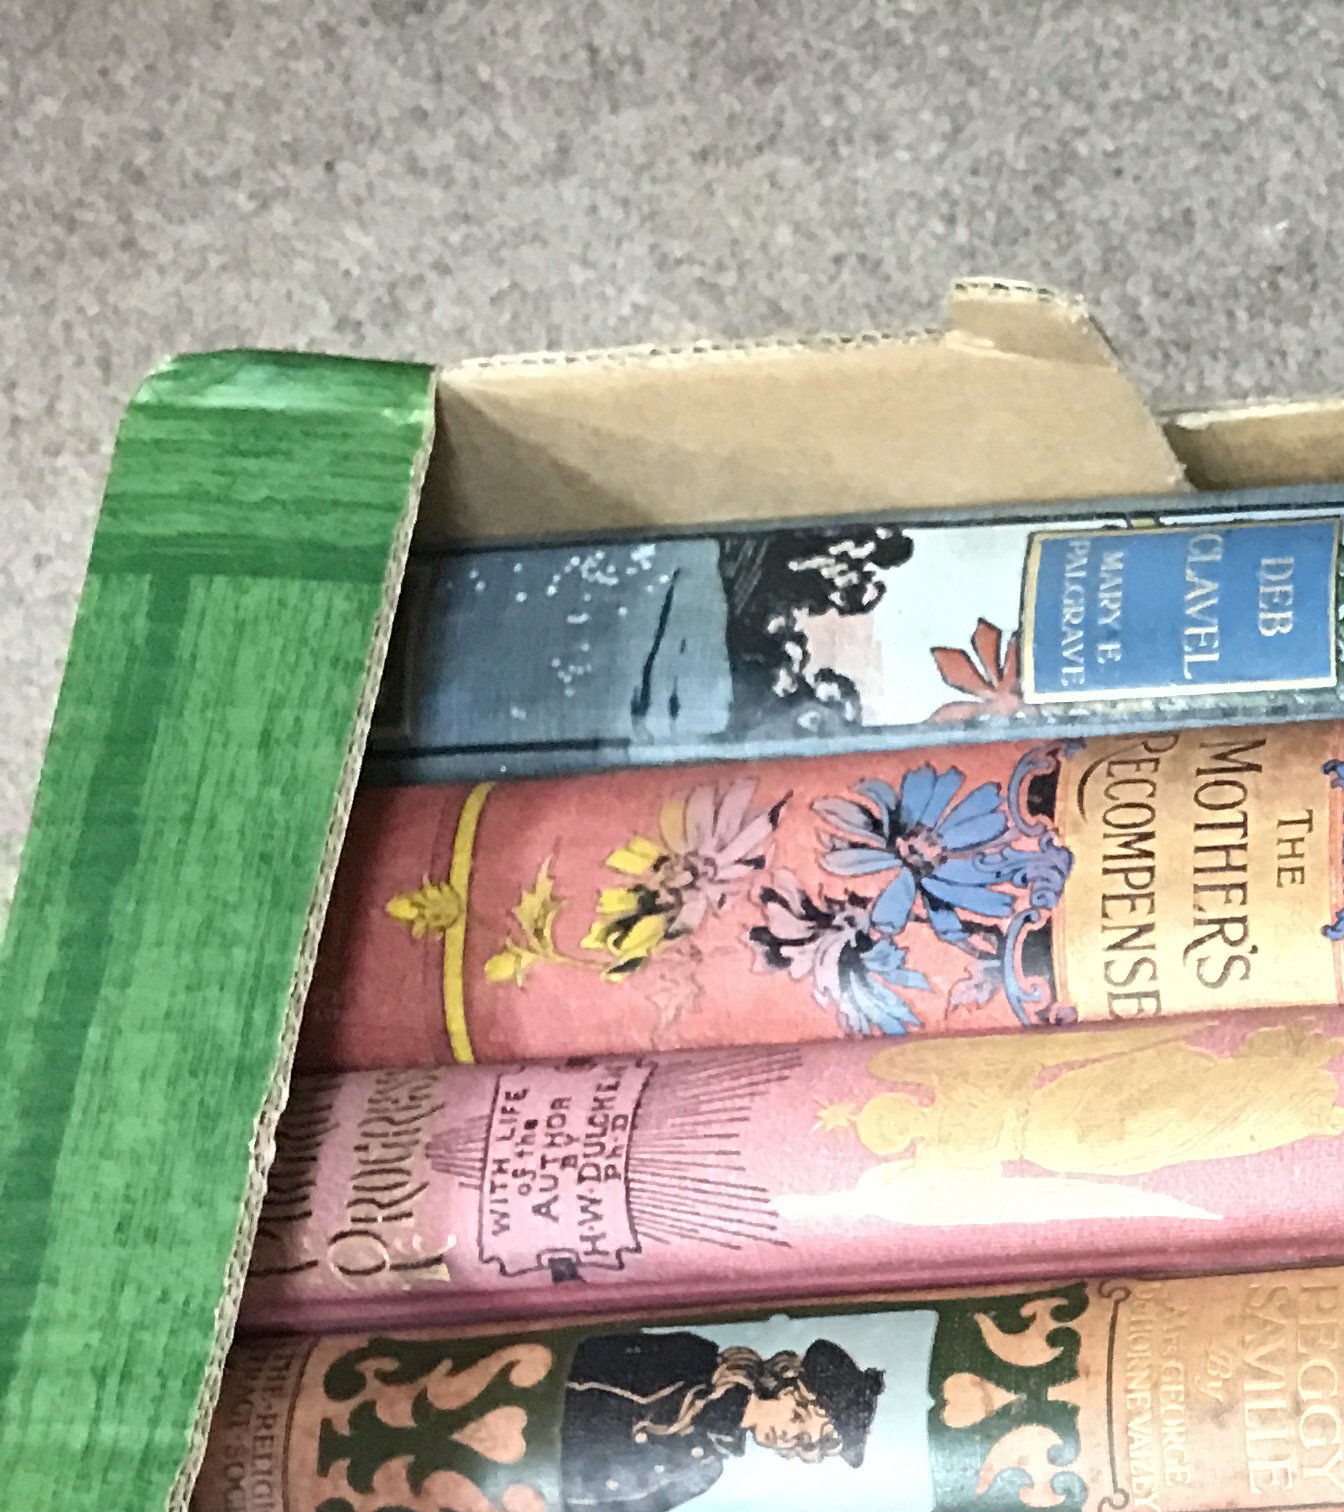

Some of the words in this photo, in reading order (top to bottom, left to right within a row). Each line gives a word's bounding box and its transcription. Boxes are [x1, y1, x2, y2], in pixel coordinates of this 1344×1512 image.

[1059, 538, 1092, 688] PALGRAVE
[1096, 550, 1125, 634] MARY
[1182, 531, 1224, 681] CLAVEL
[1257, 555, 1295, 639] DEB
[1182, 738, 1267, 990] MOTHER'S
[1276, 808, 1314, 889] THE
[494, 1087, 529, 1143] LIFE
[515, 1118, 540, 1163] the
[560, 1134, 583, 1171] BY
[490, 1157, 511, 1238] WITH
[515, 1168, 539, 1197] of
[532, 1095, 574, 1223] AUTHOR
[1198, 1348, 1233, 1405] By
[1242, 1281, 1294, 1496] SAVILLE
[1158, 1360, 1192, 1488] GEORGE
